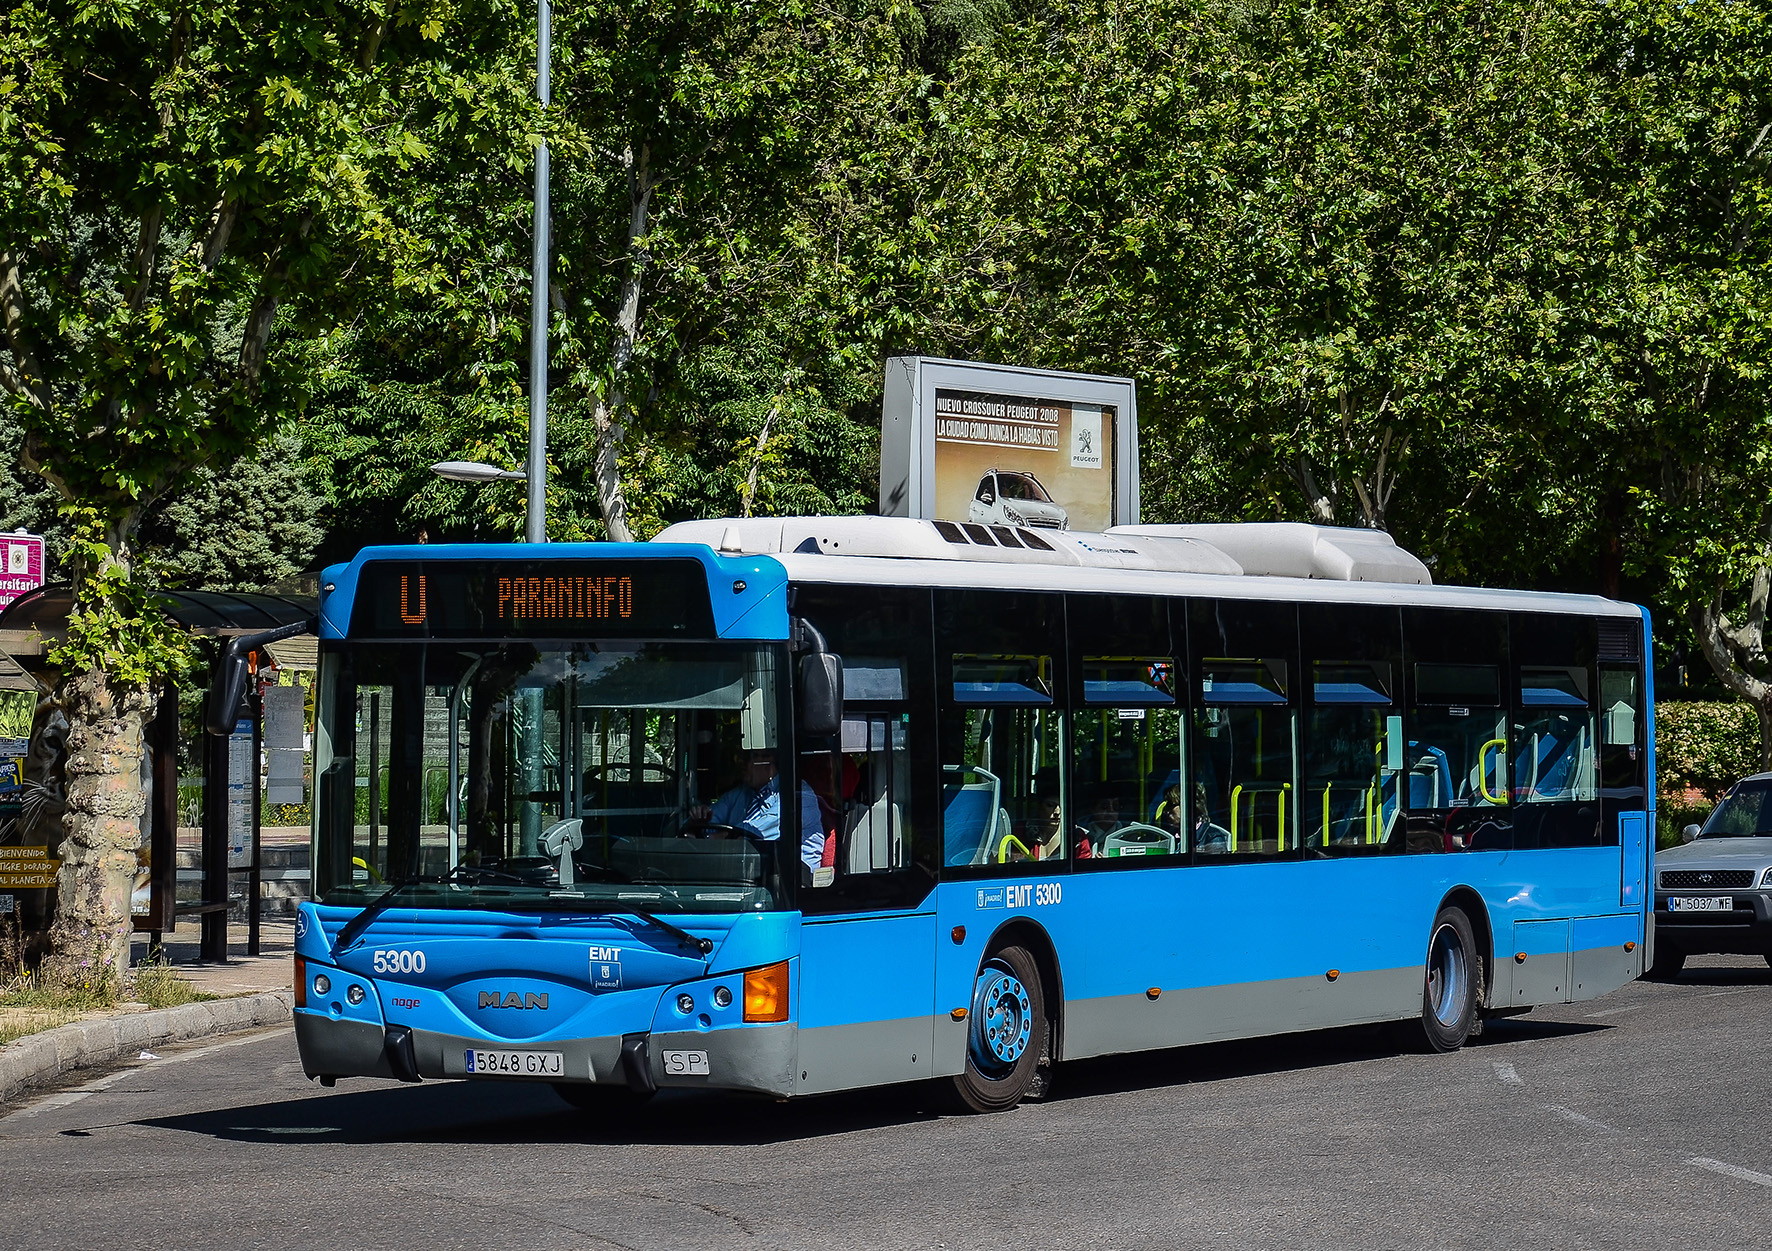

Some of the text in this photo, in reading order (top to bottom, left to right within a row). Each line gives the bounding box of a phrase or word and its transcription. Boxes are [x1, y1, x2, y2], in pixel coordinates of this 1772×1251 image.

[937, 398, 1059, 422] NUEVO CROSSOVER PEUGEOT 2008
[936, 419, 1058, 446] LA CIUDAD COMO NUNCA LA HABÍAS VISTO
[401, 575, 632, 624] U PARANINFO
[0, 848, 45, 858] BIENVENIDO
[0, 862, 52, 871] TIGRE DORADO
[11, 875, 46, 885] PLANETA
[1006, 882, 1062, 908] EMT 5300
[372, 950, 427, 974] 5300
[589, 946, 621, 962] EMT
[477, 990, 549, 1010] MAN
[477, 1053, 560, 1073] 5848 GXJ
[667, 1053, 703, 1071] SP
